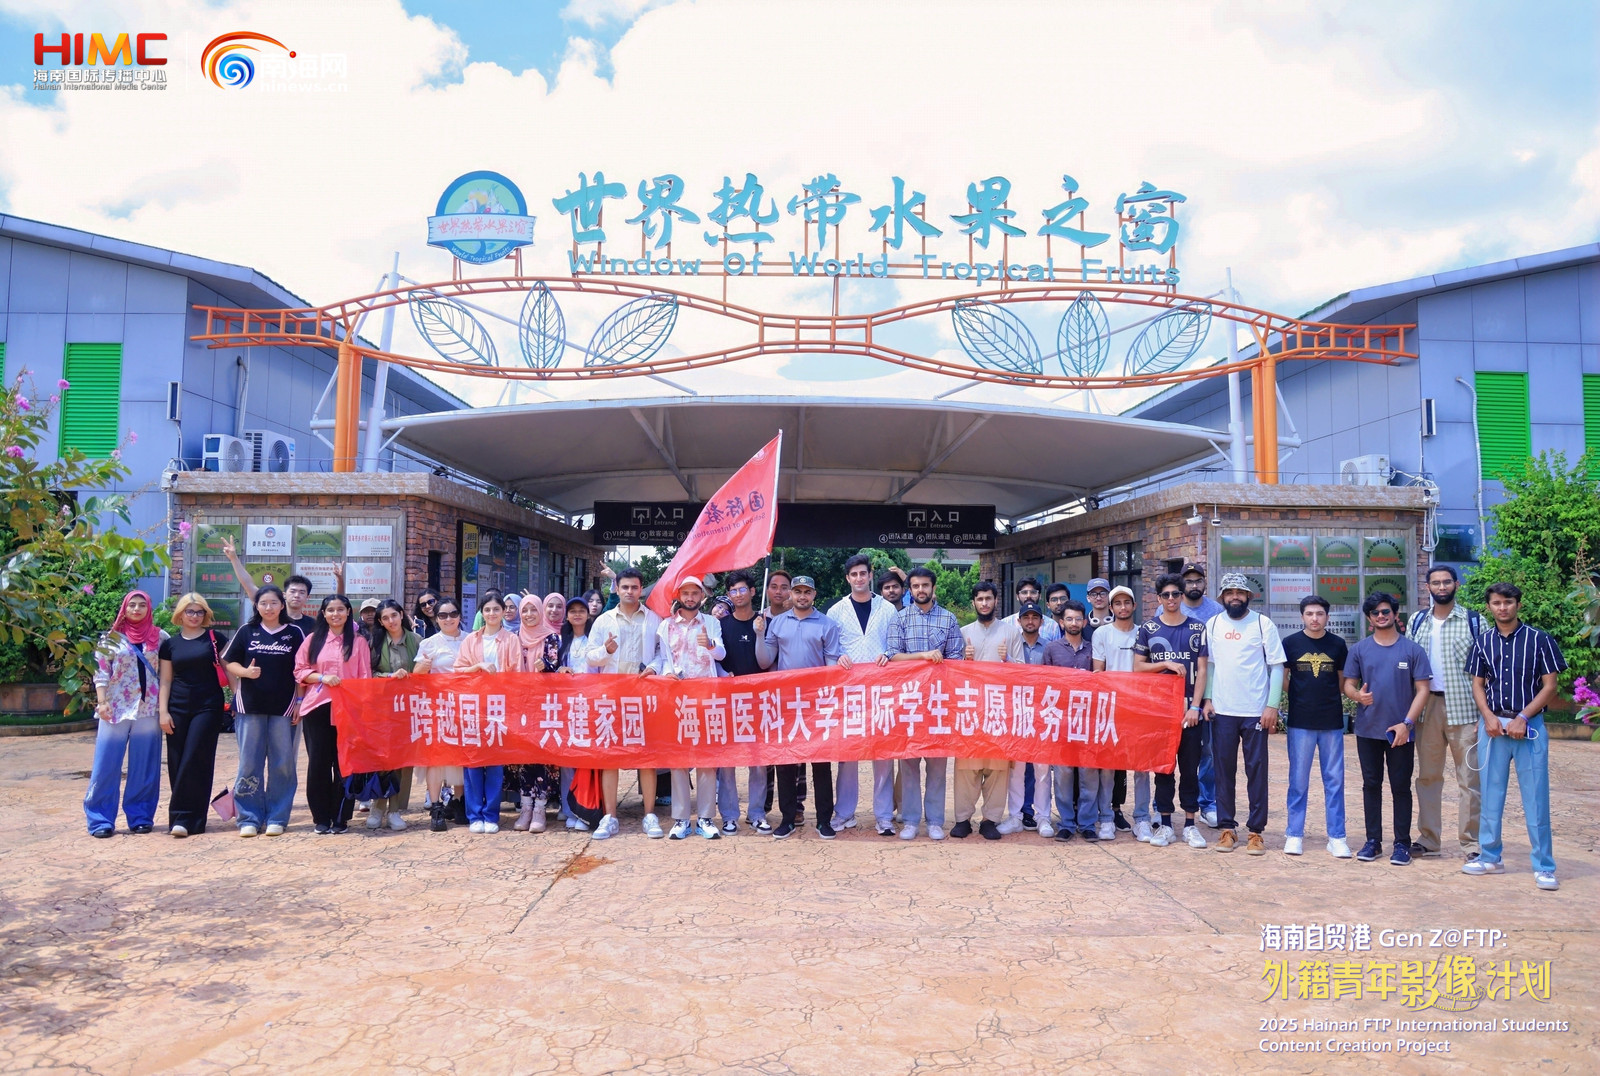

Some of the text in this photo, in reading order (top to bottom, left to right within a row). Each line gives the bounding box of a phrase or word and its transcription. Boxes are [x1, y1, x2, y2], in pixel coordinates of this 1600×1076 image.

[552, 171, 1187, 254] 世界热带水果之窗
[567, 250, 1180, 286] Window Of World Tropical Fruits
[655, 507, 684, 519] 入口
[931, 510, 959, 522] 入口
[674, 680, 1120, 747] 海南医科大学国际学生志愿服务团队
